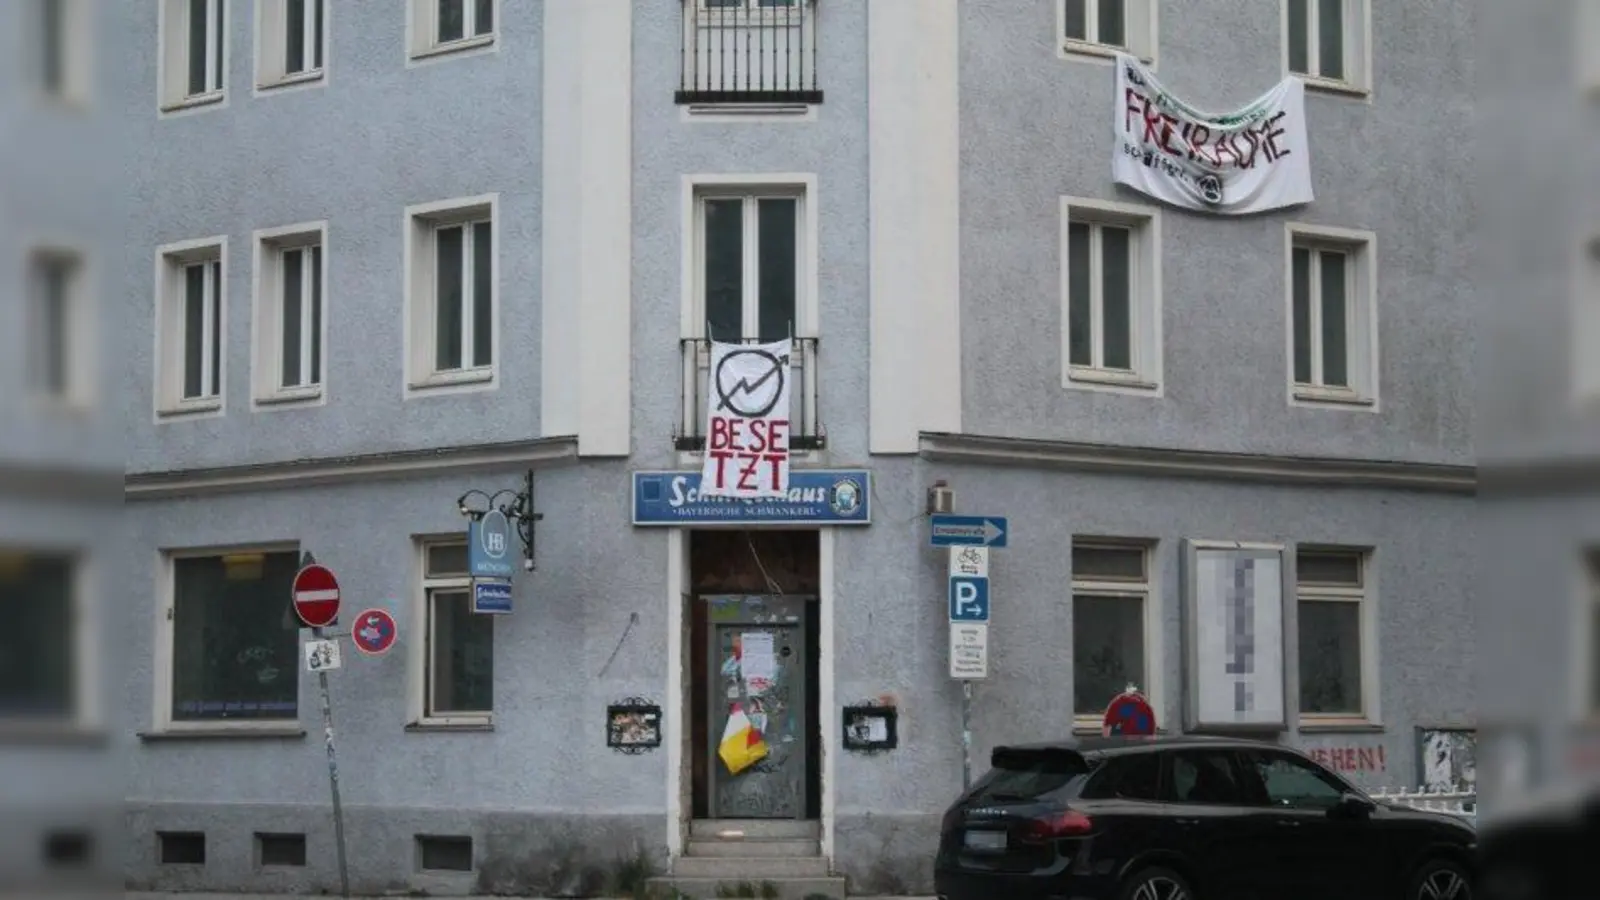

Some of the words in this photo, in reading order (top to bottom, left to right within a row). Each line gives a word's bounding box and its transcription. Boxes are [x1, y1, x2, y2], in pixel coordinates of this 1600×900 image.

[711, 416, 789, 453] BESE
[710, 451, 786, 490] TZT
[678, 506, 740, 516] BAYERISCHE
[744, 506, 816, 516] SCHMANKERL
[956, 582, 978, 616] P
